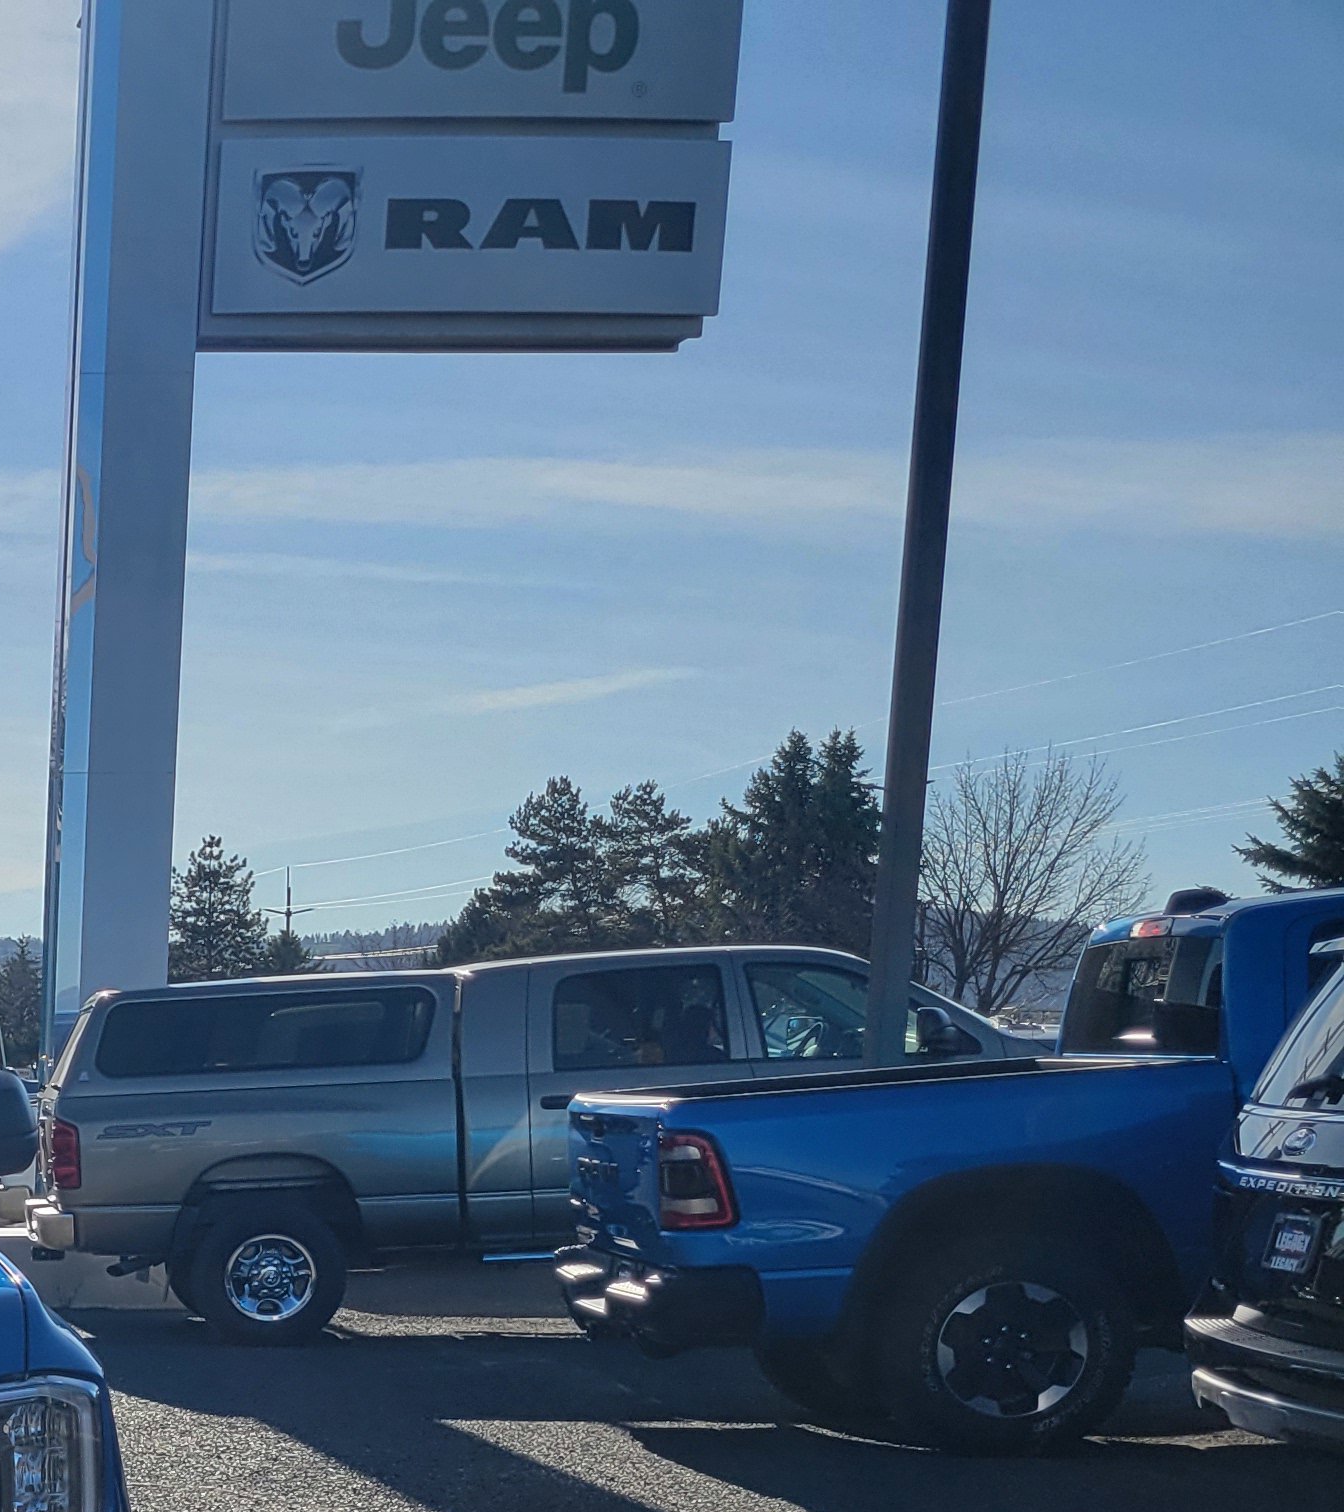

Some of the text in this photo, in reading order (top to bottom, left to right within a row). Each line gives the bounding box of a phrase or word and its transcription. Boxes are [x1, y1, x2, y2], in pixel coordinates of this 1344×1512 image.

[337, 0, 640, 93] Jeep
[386, 198, 696, 252] RAM
[97, 1120, 212, 1140] SXT
[1239, 1176, 1341, 1198] EXPEDITION
[1276, 1231, 1310, 1253] LEGACY
